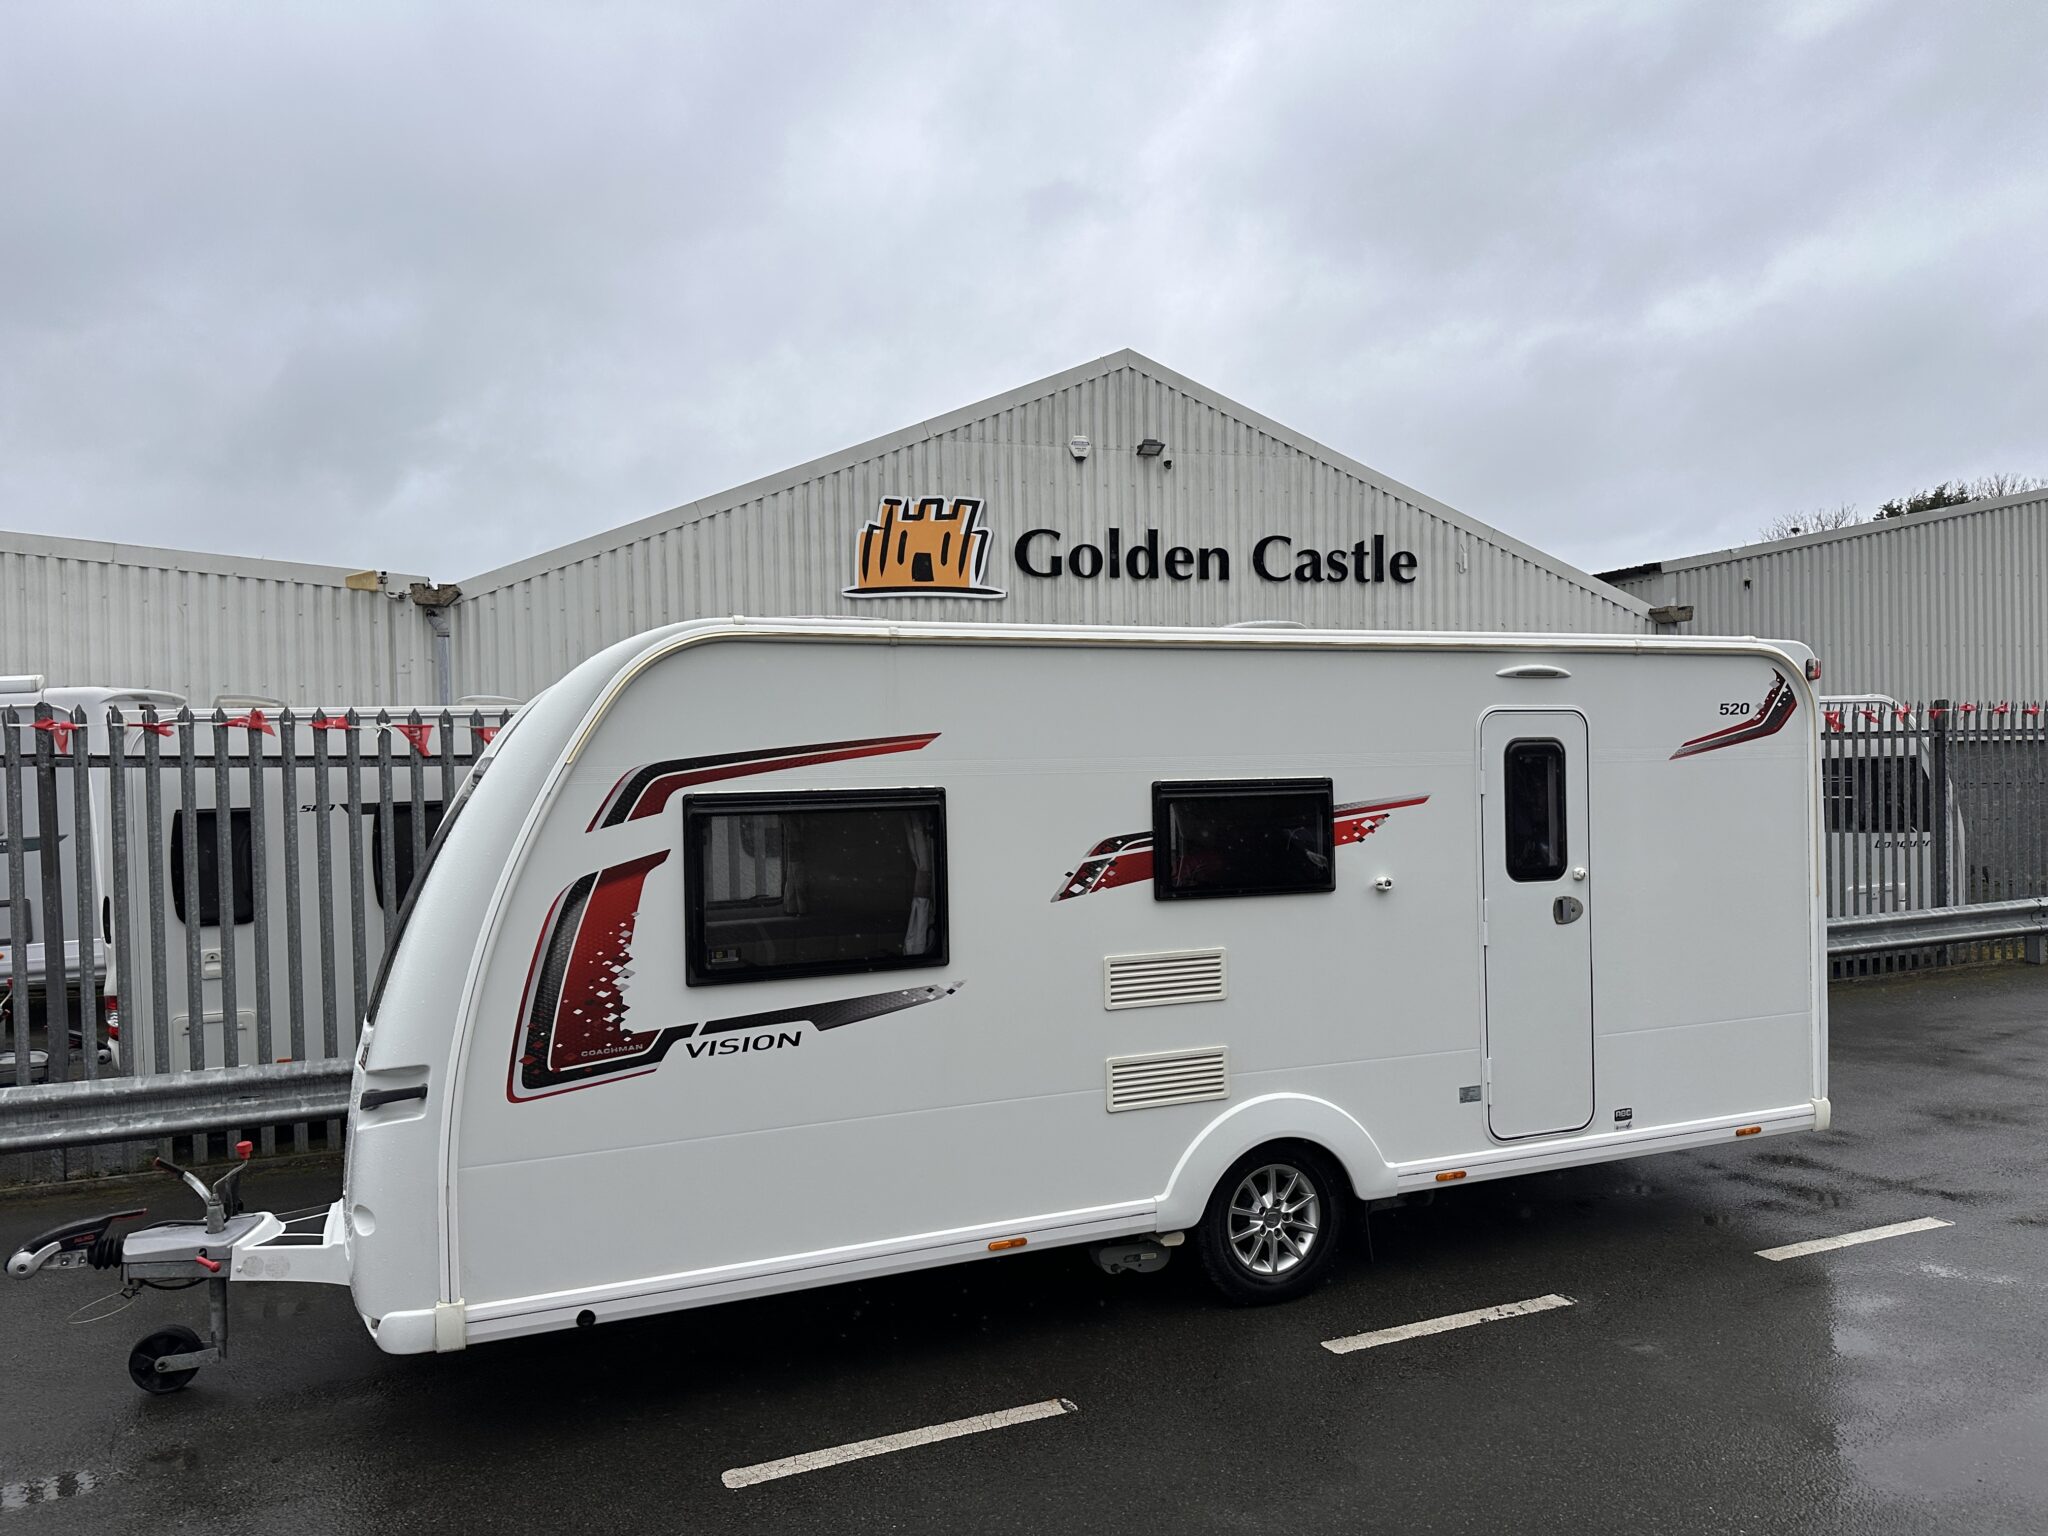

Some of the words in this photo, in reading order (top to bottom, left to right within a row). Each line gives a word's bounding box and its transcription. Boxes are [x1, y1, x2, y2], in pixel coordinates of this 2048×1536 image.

[1014, 527, 1231, 580] Golden
[1252, 534, 1418, 583] Castle
[1719, 702, 1750, 716] 520
[580, 1043, 644, 1058] COACHMAN
[685, 1031, 802, 1059] VISION
